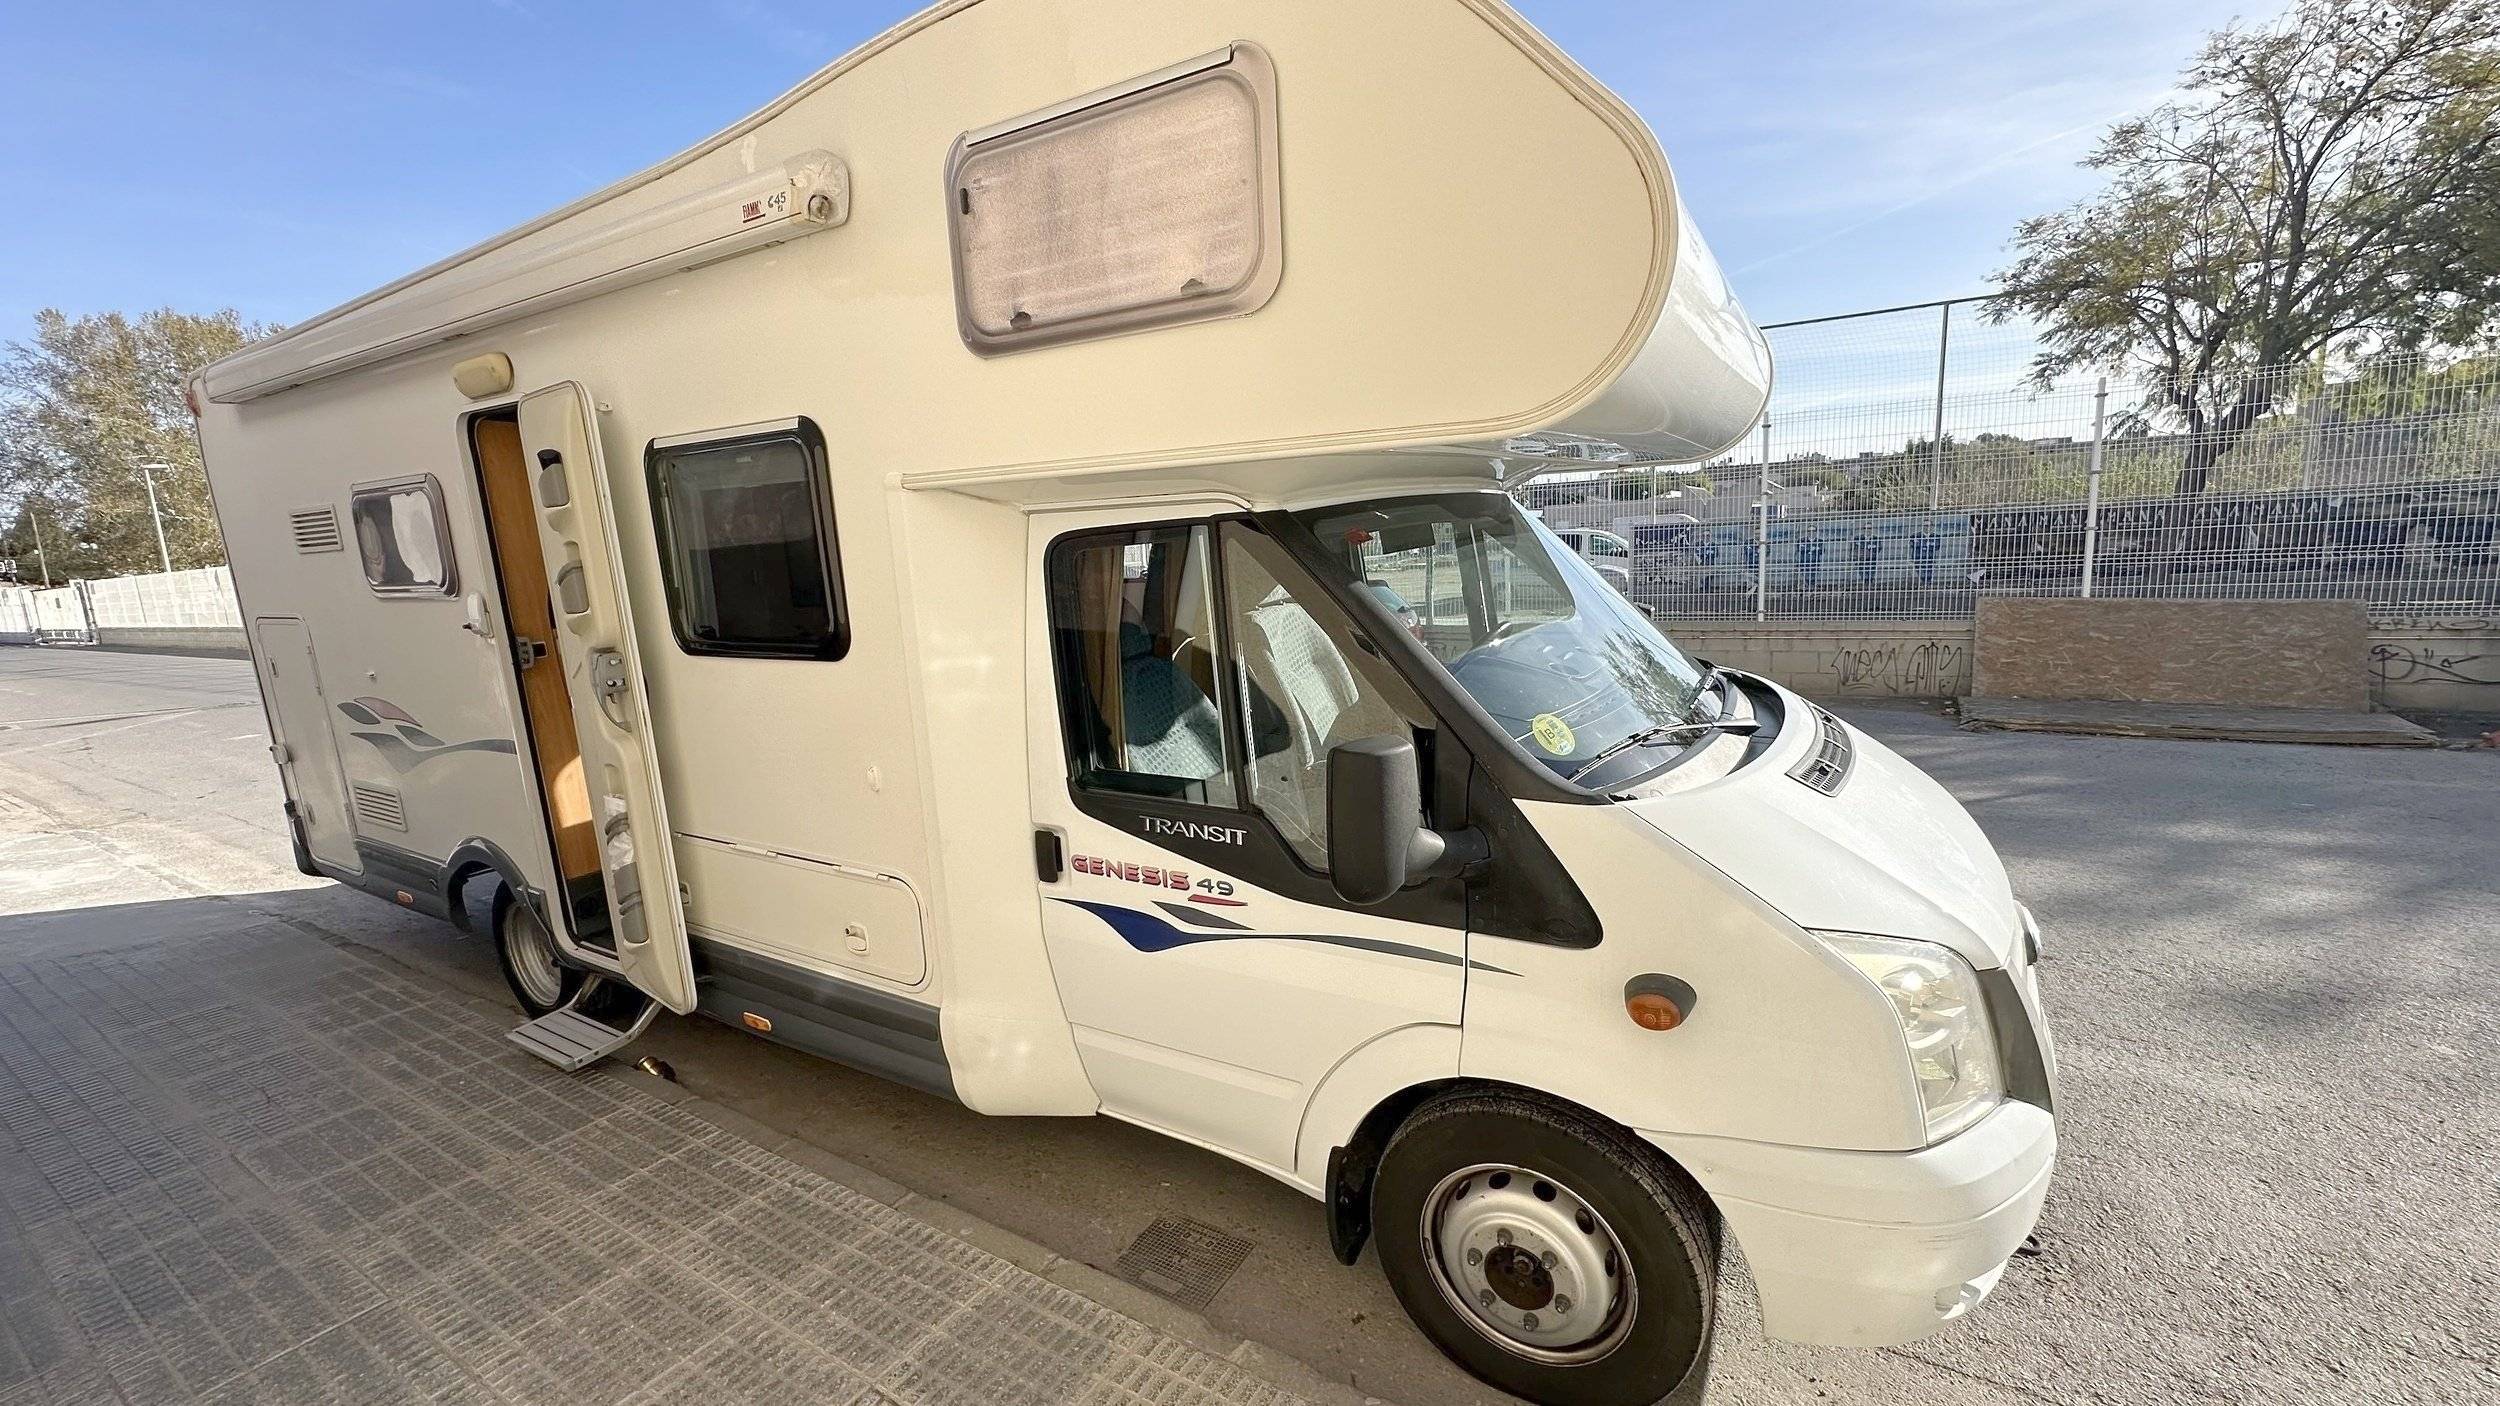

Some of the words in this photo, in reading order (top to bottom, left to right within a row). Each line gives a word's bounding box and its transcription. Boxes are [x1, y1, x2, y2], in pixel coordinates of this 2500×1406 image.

[1139, 815, 1248, 846] TRANSIT
[1071, 854, 1191, 891] GENESIS
[1196, 878, 1235, 896] 49
